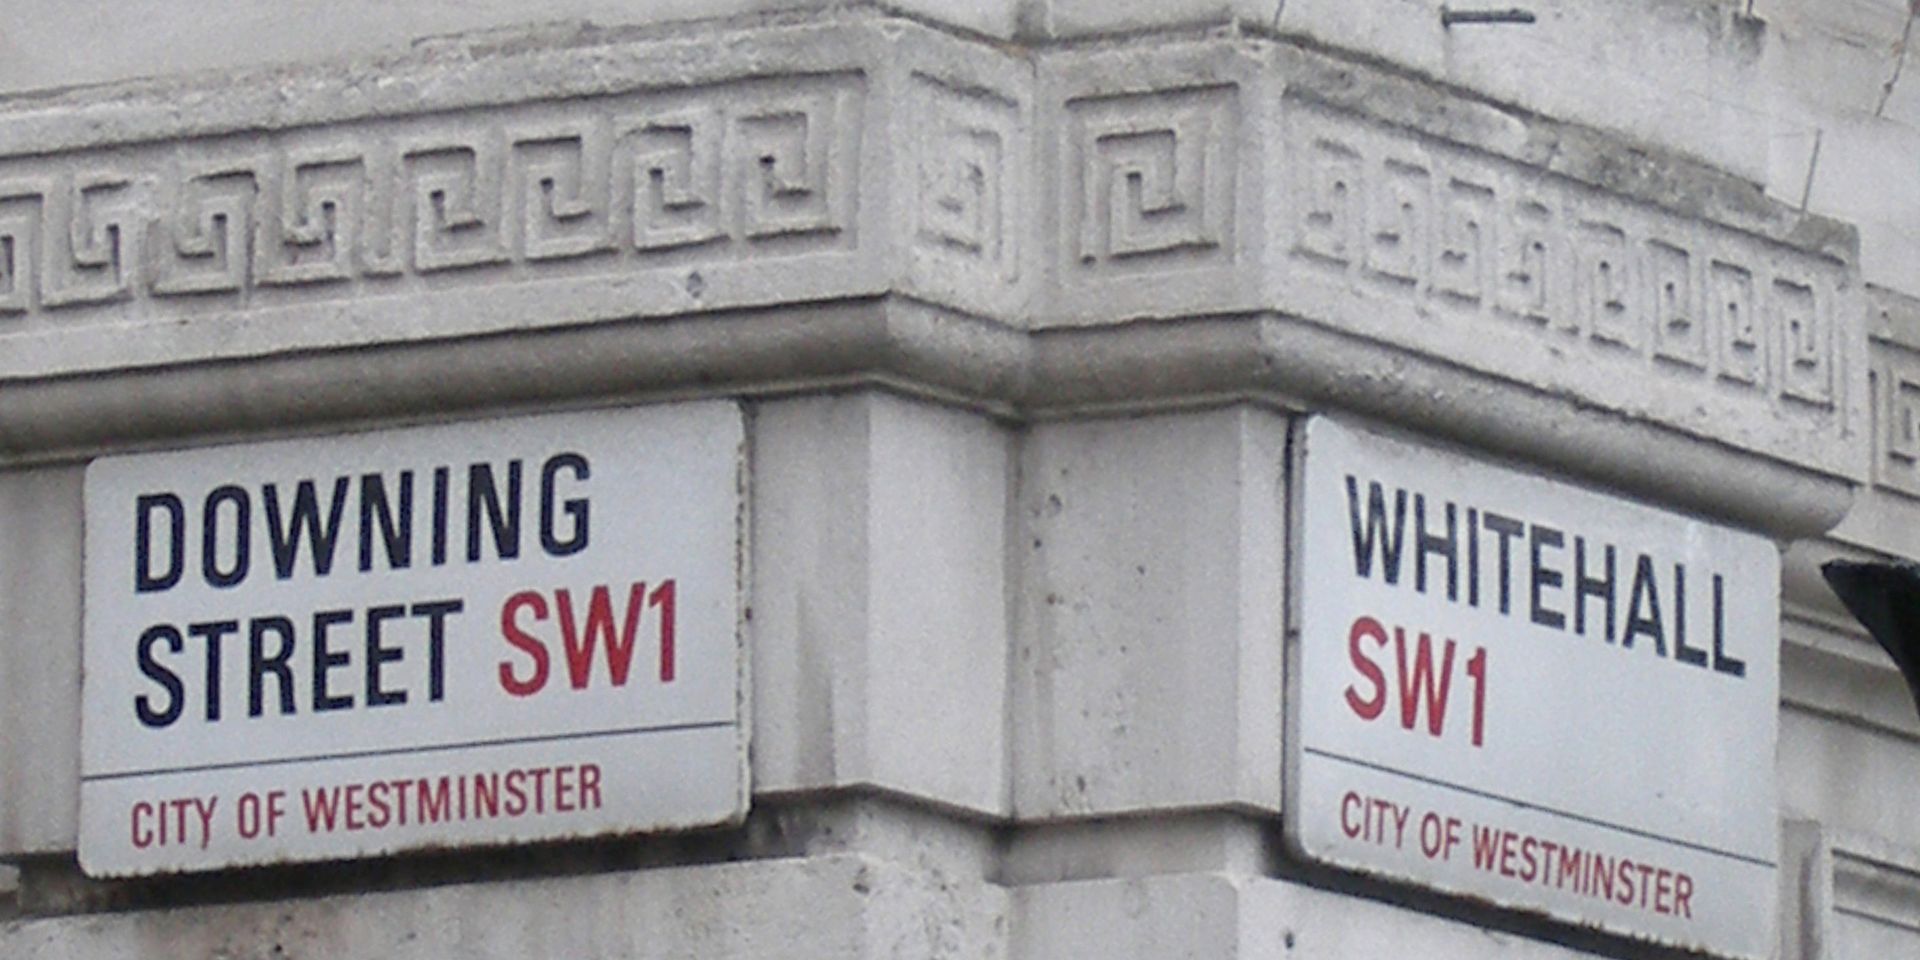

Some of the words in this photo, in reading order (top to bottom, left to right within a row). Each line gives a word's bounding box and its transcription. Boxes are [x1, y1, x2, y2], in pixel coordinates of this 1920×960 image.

[135, 452, 590, 593] DOWNING
[1346, 475, 1746, 677] WHITEHALL
[135, 600, 463, 727] STREET
[499, 579, 677, 698] SW1
[1344, 617, 1487, 748] SW1
[132, 796, 217, 849] CITY
[238, 790, 286, 839] OF
[303, 764, 602, 832] WESTMINSTER
[1341, 791, 1410, 850] CITY
[1421, 812, 1462, 860] OF
[1473, 826, 1693, 919] WESTMINSTER
